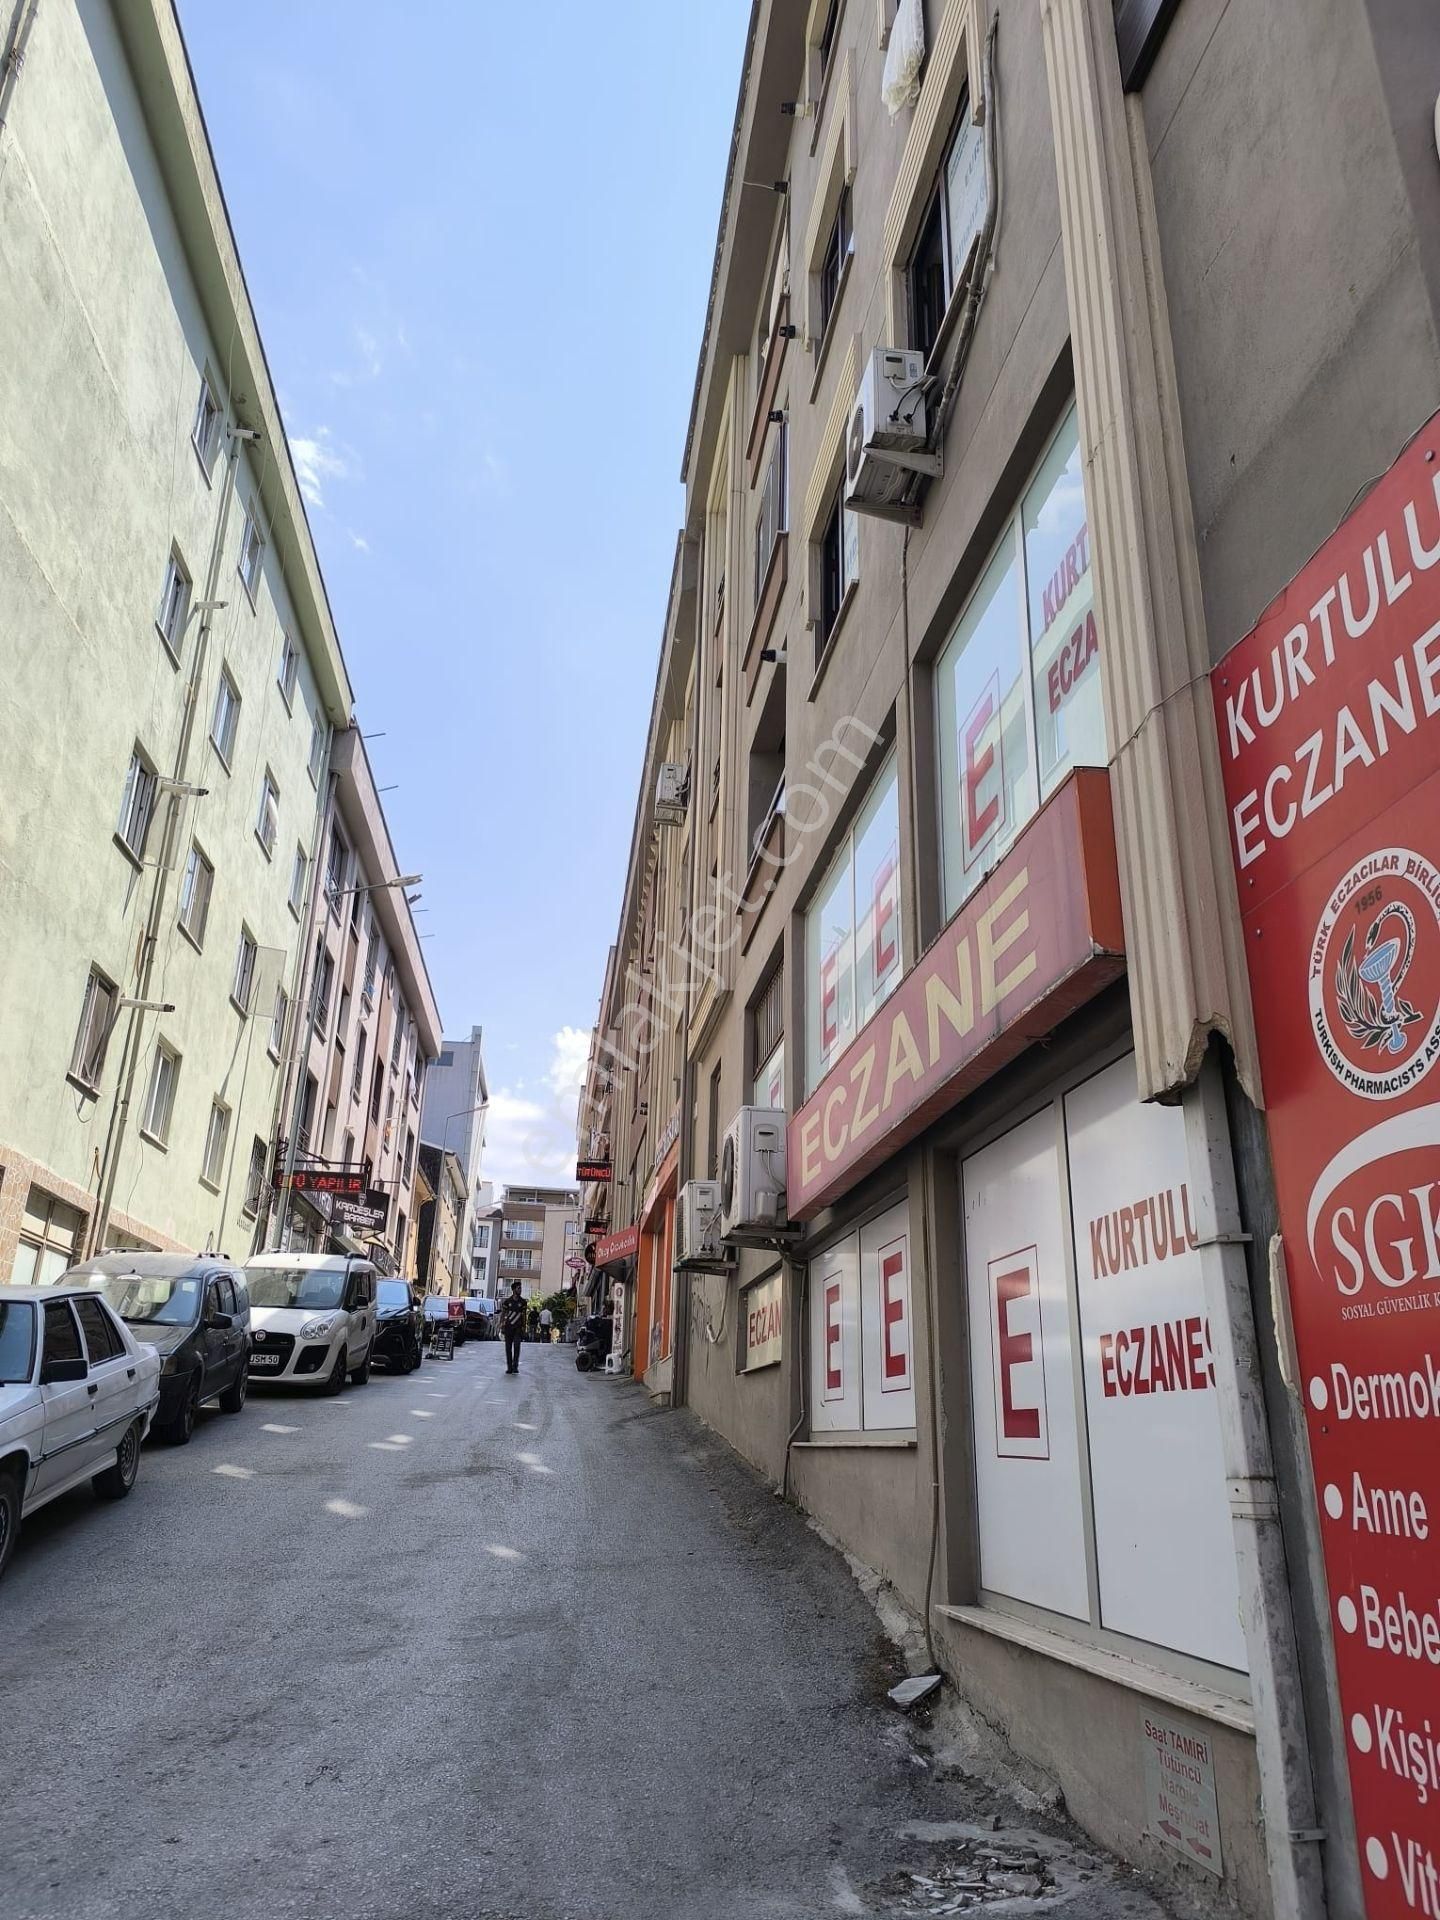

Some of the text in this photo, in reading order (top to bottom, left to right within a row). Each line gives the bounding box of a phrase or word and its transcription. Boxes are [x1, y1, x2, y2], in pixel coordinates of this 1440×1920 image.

[1047, 609, 1099, 714] ECZA
[1311, 921, 1330, 979] TÜRK
[1330, 855, 1400, 914] ECZACILAR
[1354, 885, 1383, 915] 1956
[801, 866, 1037, 1189] ECZANE
[1314, 1007, 1344, 1076] TURKISH
[1345, 1058, 1425, 1095] PHARMACISTS
[335, 1200, 384, 1220] KARDEŞLER
[343, 1211, 375, 1226] BARBER
[749, 1300, 782, 1348] ECZAN
[883, 1251, 906, 1378] E
[1341, 1302, 1375, 1321] SOSYAL
[1376, 1291, 1432, 1317] GÜVENLİK
[996, 1266, 1040, 1439] E
[1353, 1471, 1429, 1540] Anne
[1360, 1584, 1440, 1665] Bebe
[1144, 1719, 1209, 1765] Saat TAMİRİ
[1156, 1748, 1202, 1785] Tütüncü
[1374, 1704, 1440, 1804] Kişi
[1391, 1831, 1440, 1920] Vit
